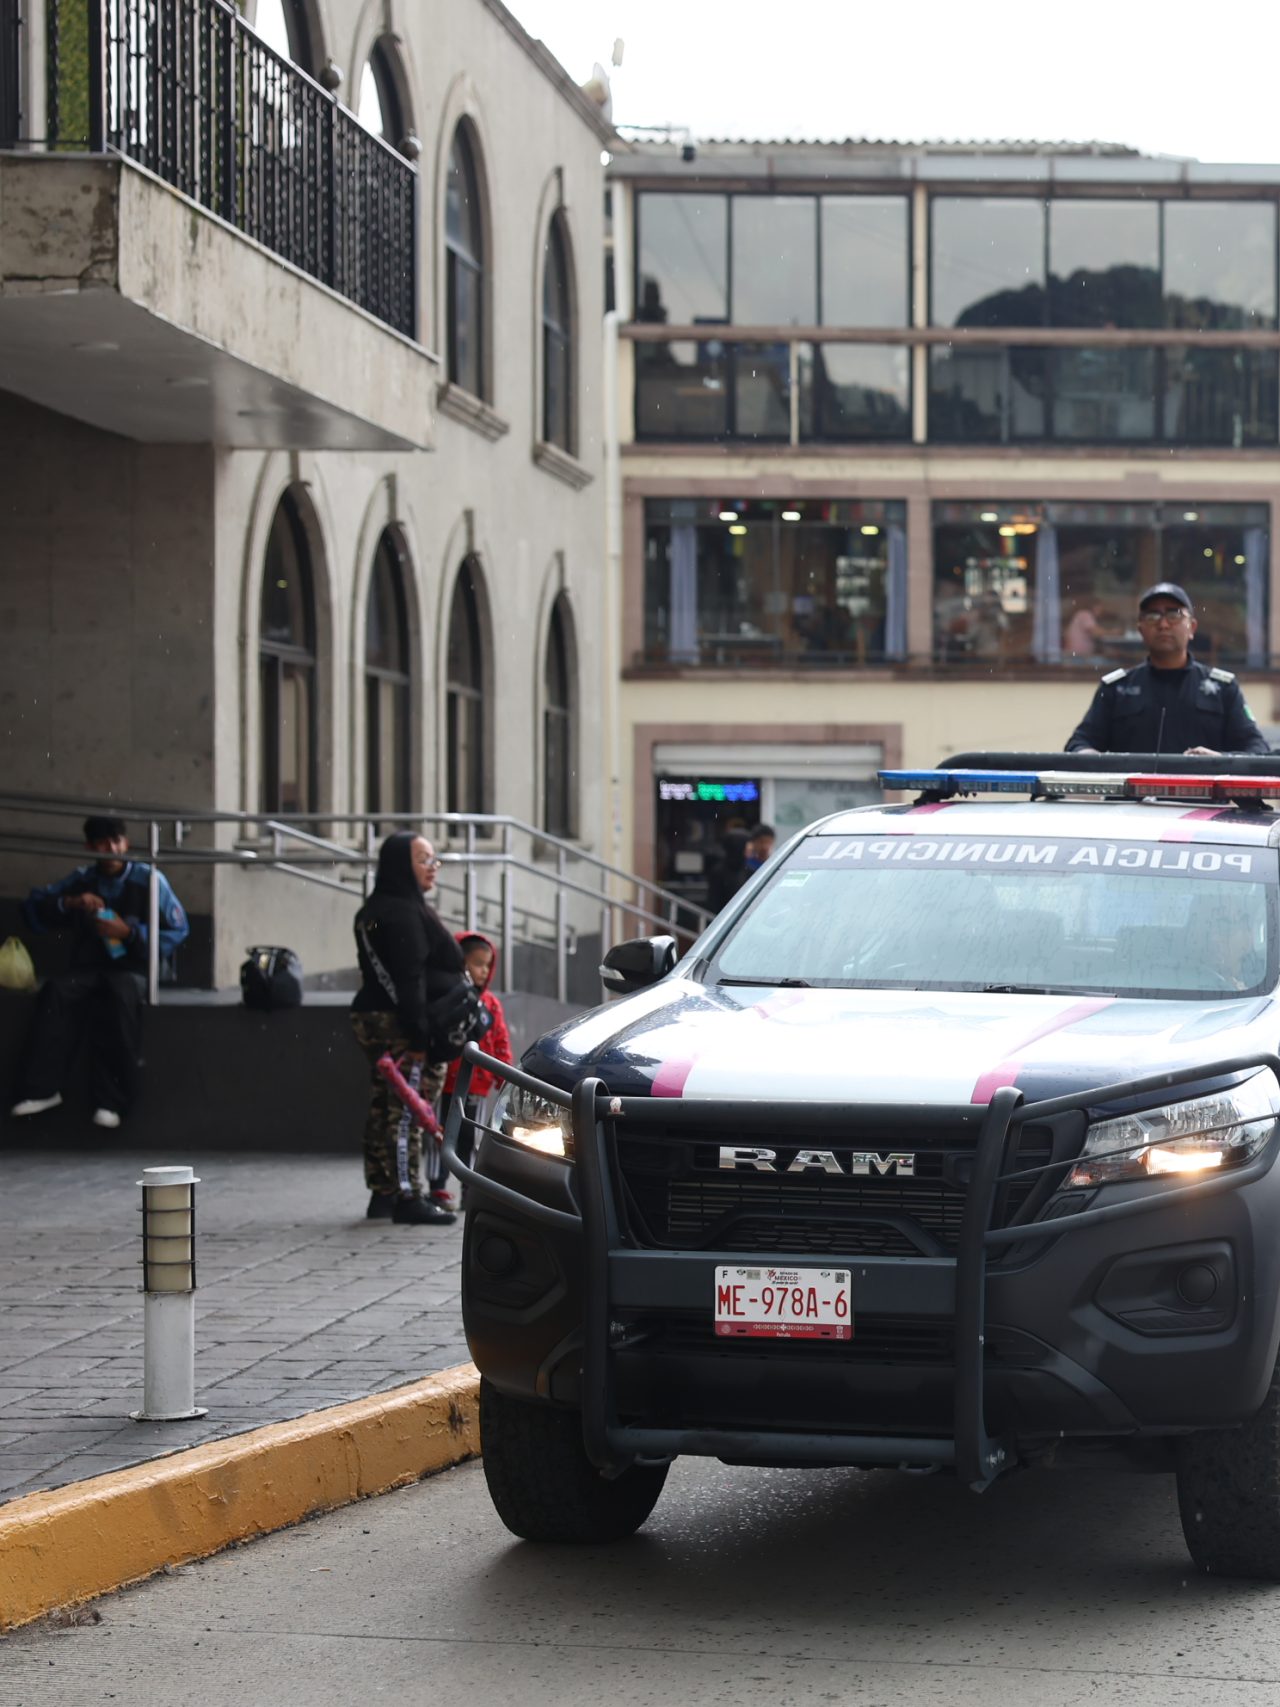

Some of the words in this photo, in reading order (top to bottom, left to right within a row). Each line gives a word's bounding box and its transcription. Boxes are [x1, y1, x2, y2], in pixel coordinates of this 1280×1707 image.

[719, 1146, 916, 1176] RAM
[722, 1270, 728, 1278] F
[718, 1284, 847, 1317] ME-978A-6
